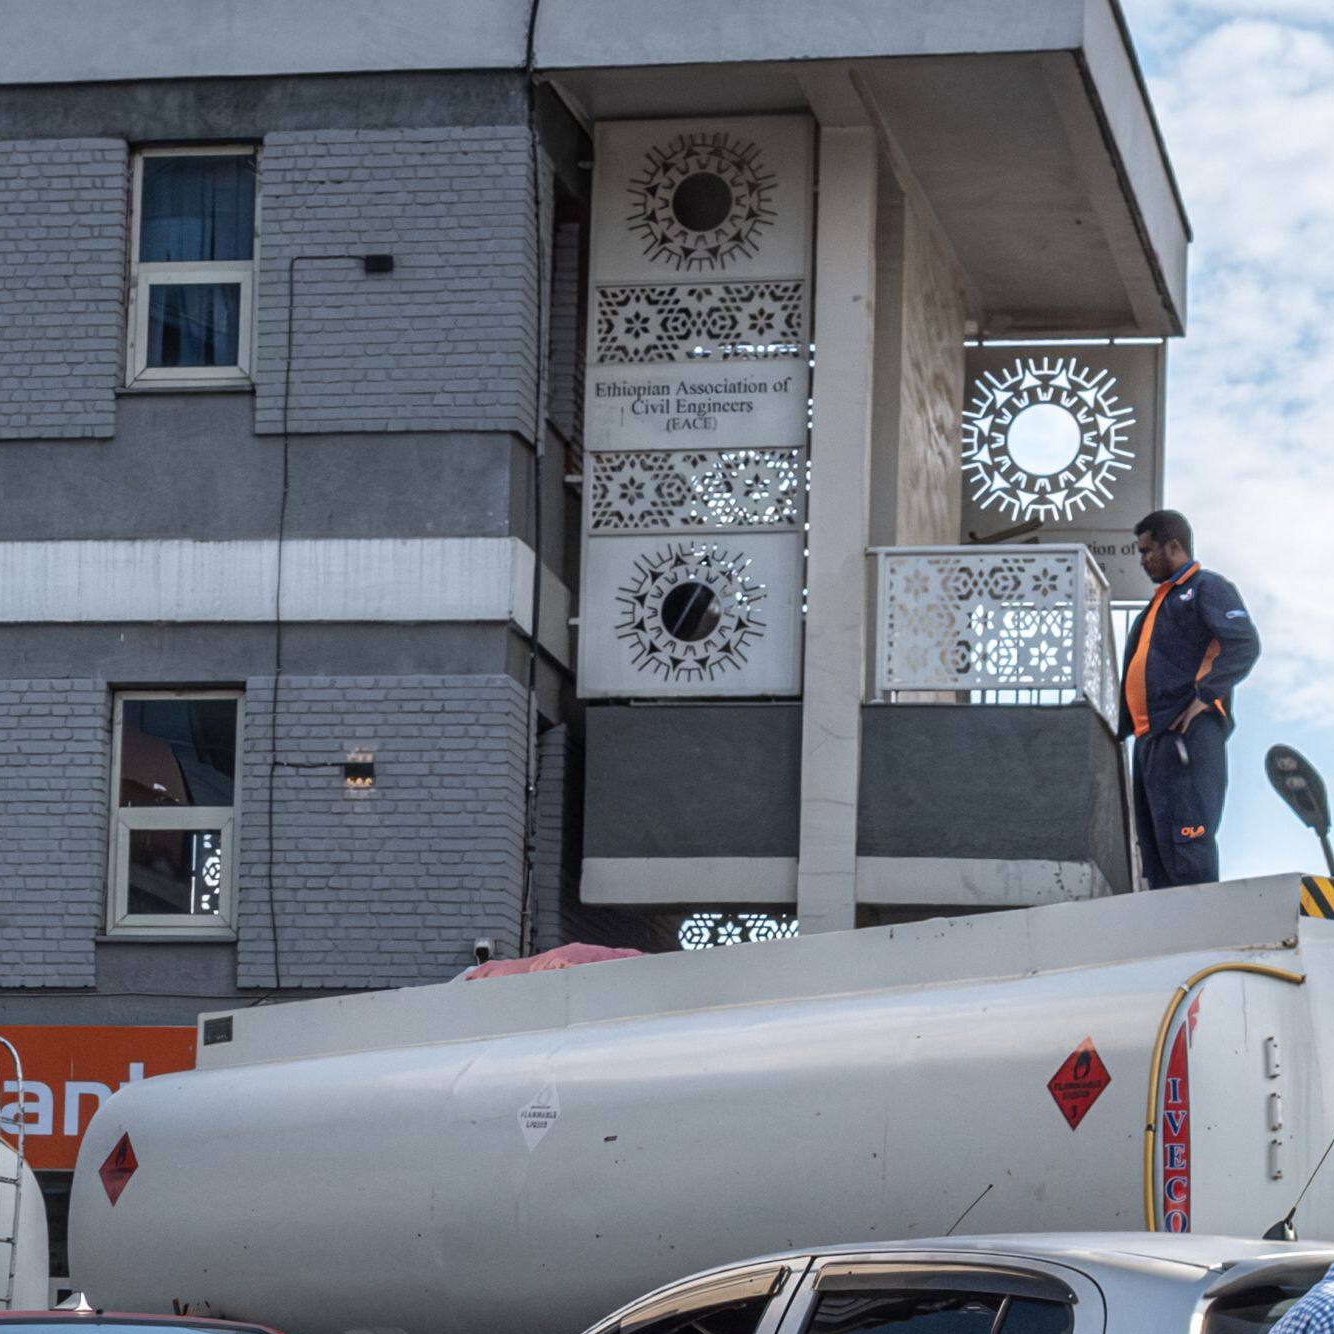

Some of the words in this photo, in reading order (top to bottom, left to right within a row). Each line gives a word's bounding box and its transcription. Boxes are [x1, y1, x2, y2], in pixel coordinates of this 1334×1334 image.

[595, 382, 670, 400] Ethiopian
[675, 378, 767, 396] Association
[773, 376, 792, 393] of
[631, 399, 670, 415] Civil
[676, 399, 754, 417] Engineers
[666, 417, 717, 433] (EACE)
[1164, 1077, 1188, 1233] IVECO
